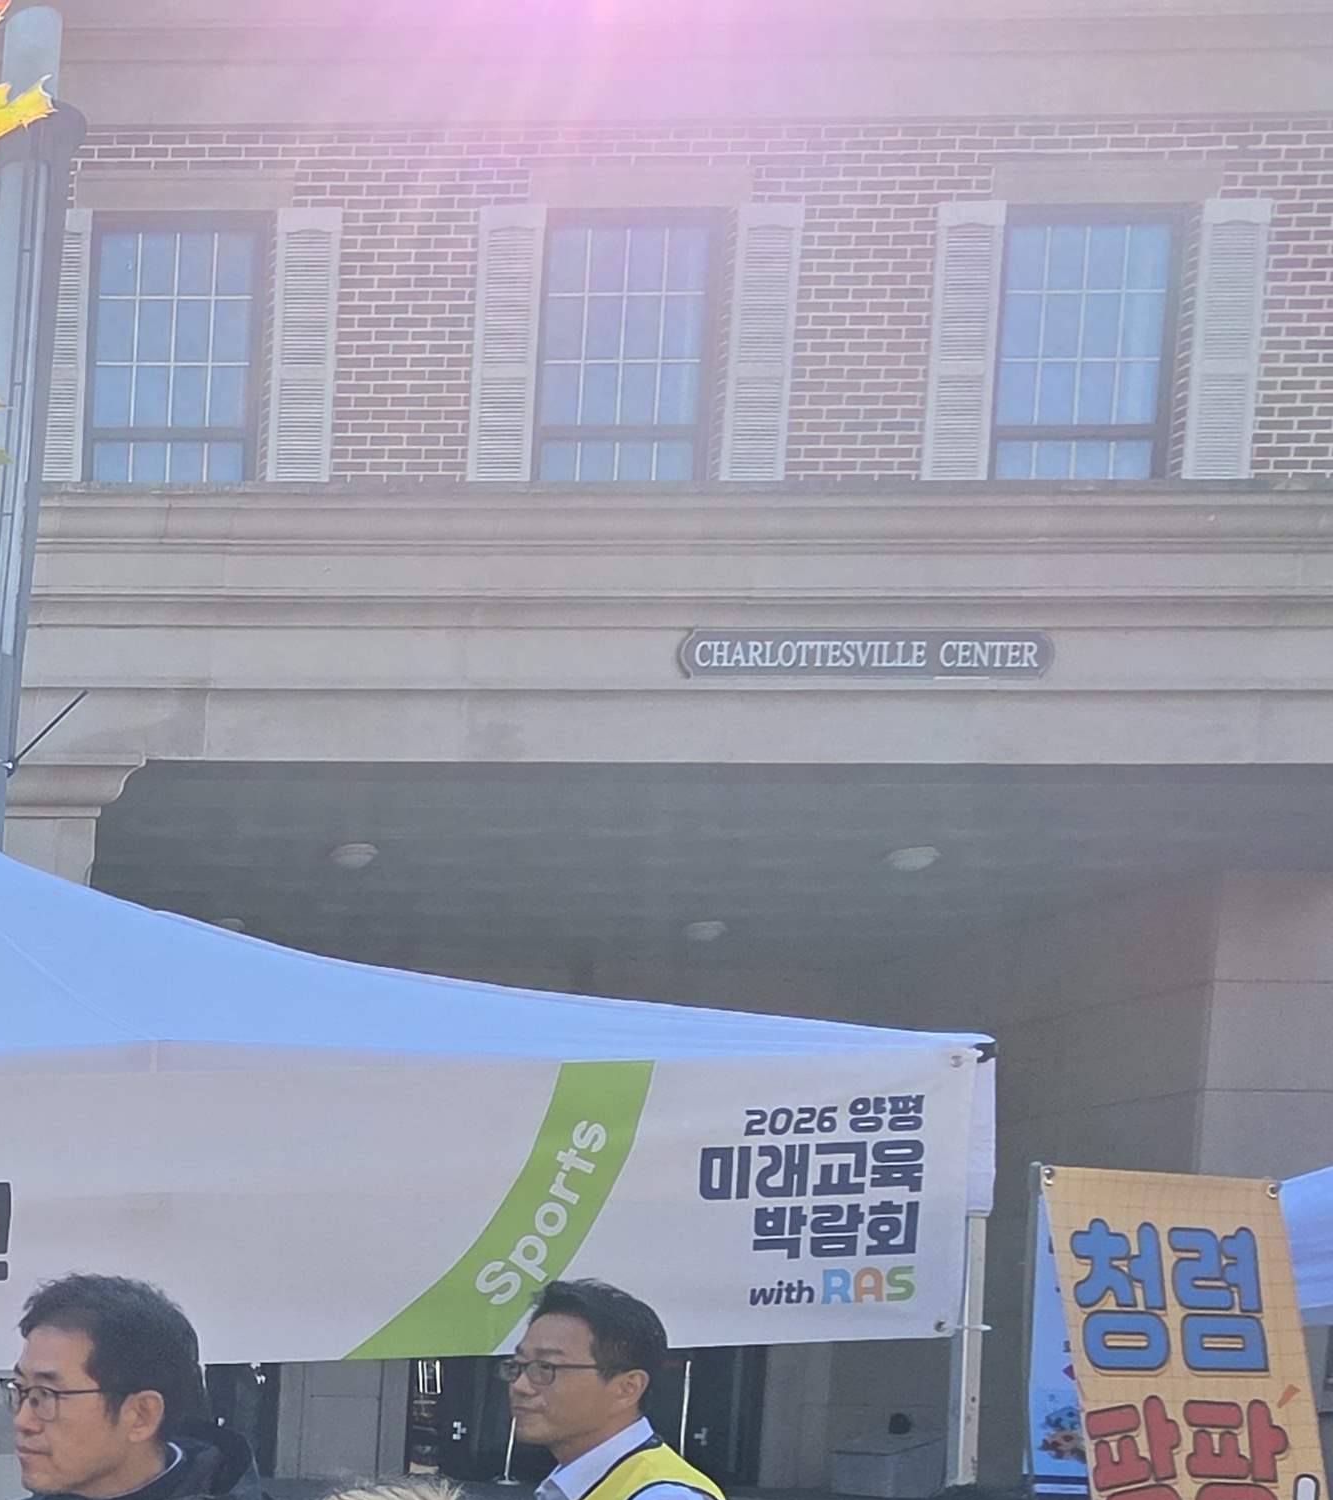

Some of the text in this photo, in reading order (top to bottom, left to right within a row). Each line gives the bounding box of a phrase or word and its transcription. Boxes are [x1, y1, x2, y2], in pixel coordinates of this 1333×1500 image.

[694, 640, 1039, 668] CHARLOTTESVILLE CENTER
[744, 1094, 925, 1137] 2026 양평
[699, 1140, 925, 1201] 미래교육
[475, 1120, 607, 1306] Sports
[751, 1200, 920, 1259] 박람회
[748, 1265, 916, 1306] with RAS
[1069, 1217, 1269, 1377] 청렴
